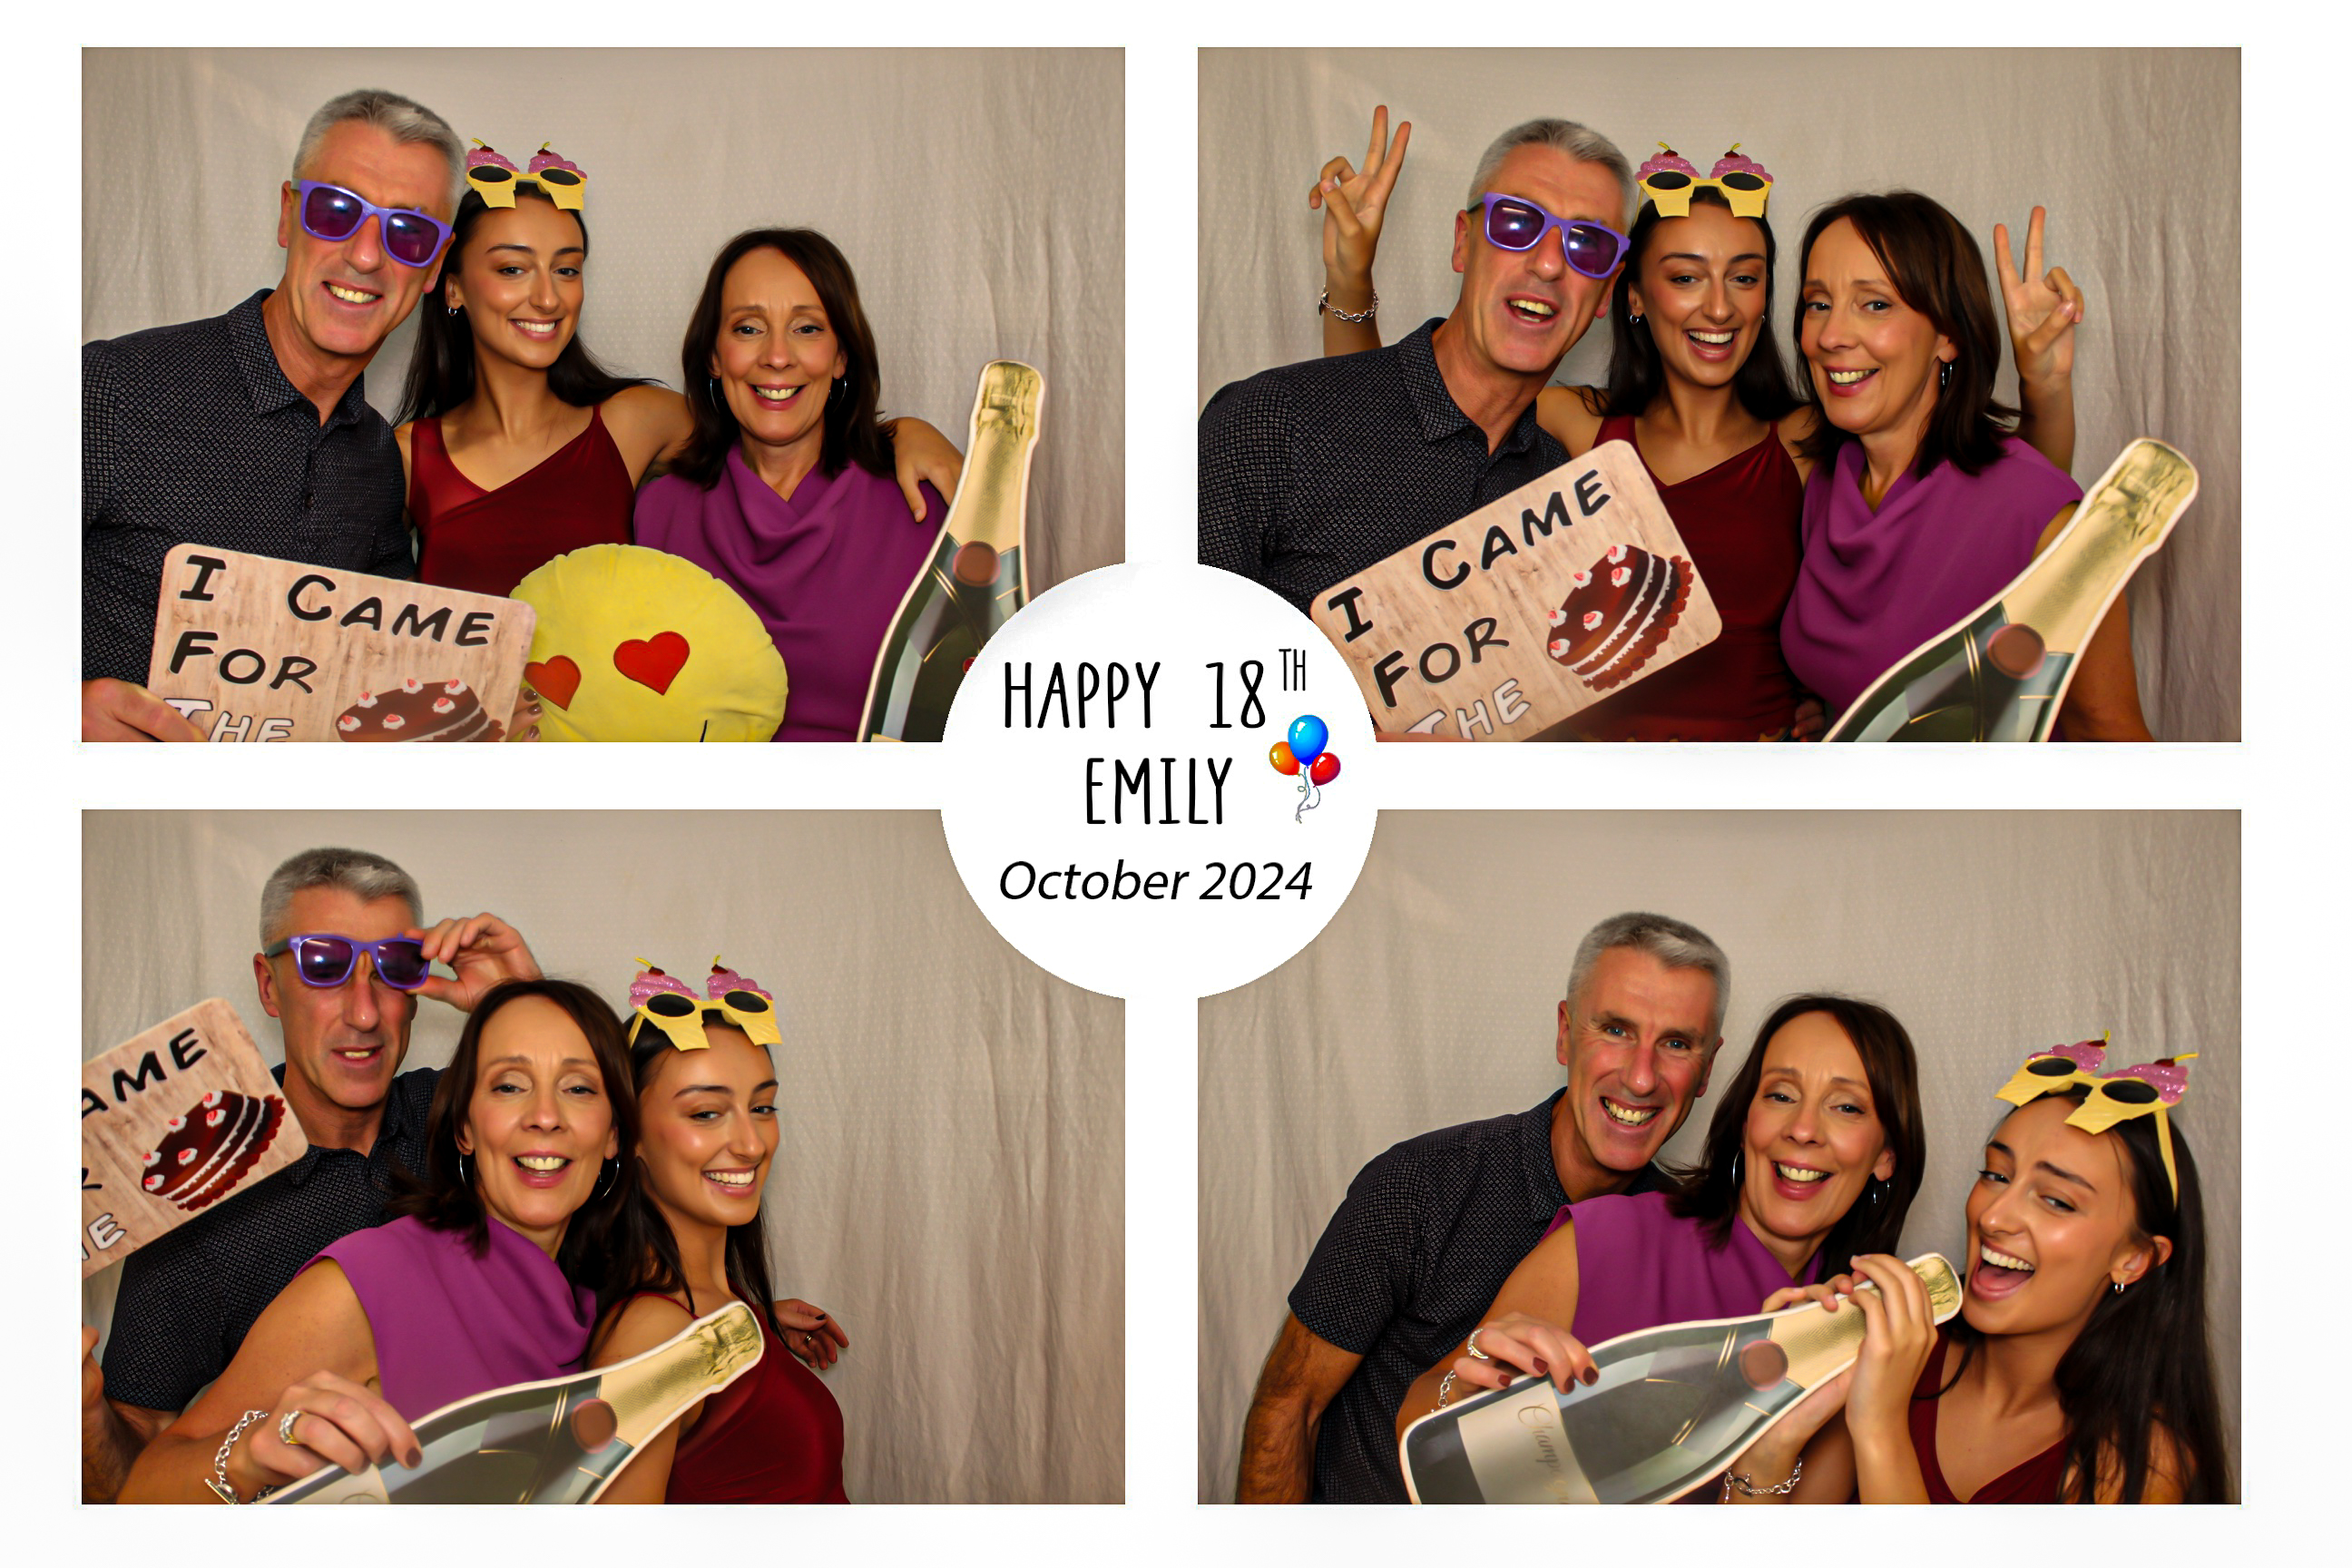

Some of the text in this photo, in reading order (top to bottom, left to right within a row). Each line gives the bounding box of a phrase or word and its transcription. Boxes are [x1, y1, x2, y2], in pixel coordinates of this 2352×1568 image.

[180, 554, 495, 647] I CAME
[1327, 469, 1612, 644] I CAME
[169, 630, 318, 695] FOR
[1372, 617, 1510, 710] FOR
